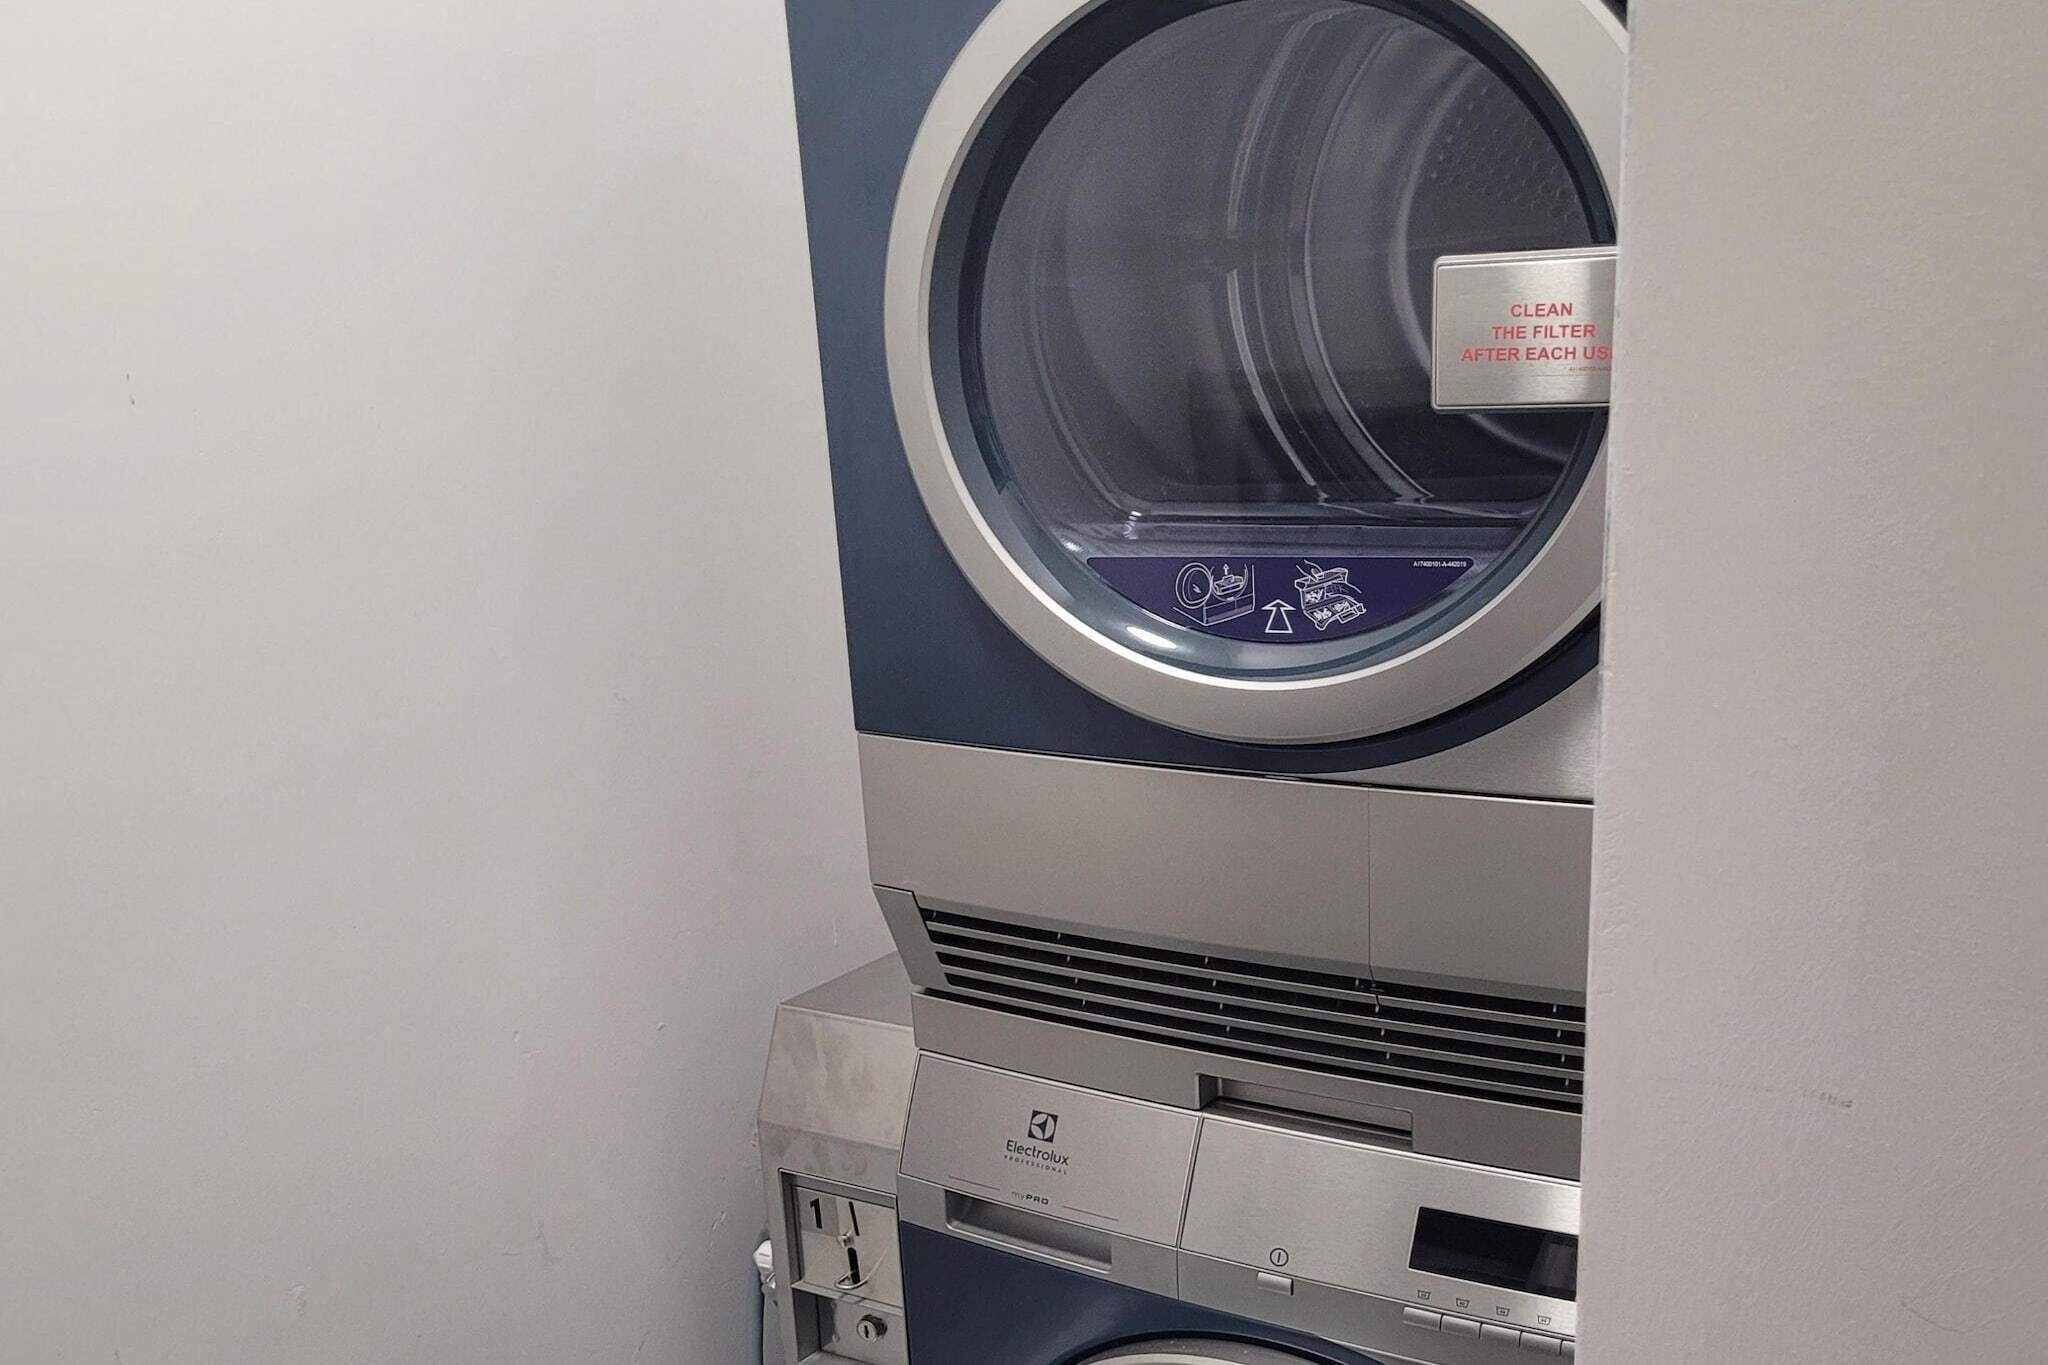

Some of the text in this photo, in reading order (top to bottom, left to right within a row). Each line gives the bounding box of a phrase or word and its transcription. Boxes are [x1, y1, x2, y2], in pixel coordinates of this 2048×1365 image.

[1510, 303, 1573, 318] CLEAN
[1492, 324, 1596, 340] THE FILTER
[1460, 346, 1613, 362] AFTER EACH US
[1005, 1139, 1070, 1166] Electrolux
[1003, 1155, 1068, 1175] PROFESSIONAL
[1011, 1191, 1050, 1205] myPRO
[809, 1198, 823, 1229] 1
